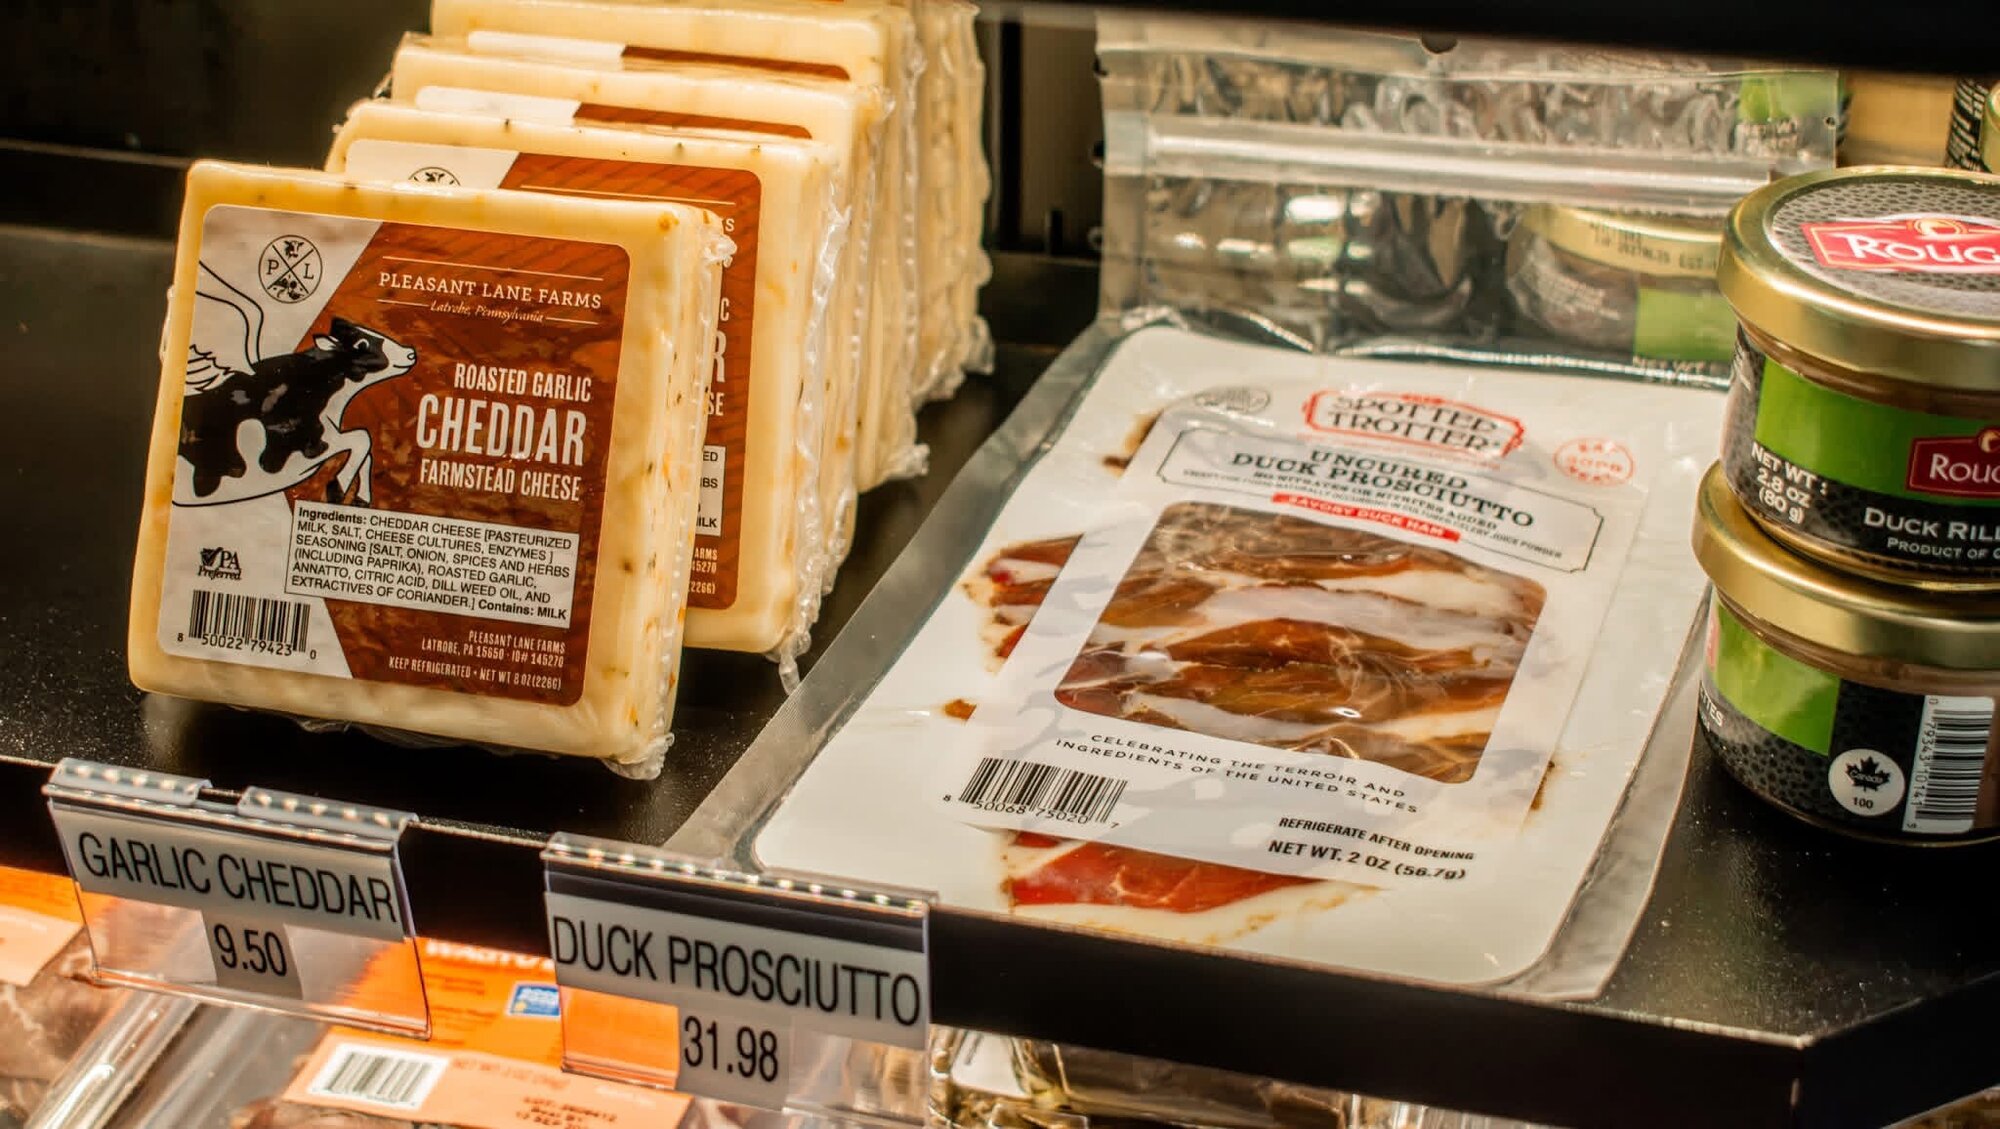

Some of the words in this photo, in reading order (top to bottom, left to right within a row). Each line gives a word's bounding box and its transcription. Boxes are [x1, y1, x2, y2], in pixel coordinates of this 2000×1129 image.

[378, 271, 477, 296] PLEASANT
[482, 282, 532, 302] LANE
[538, 288, 602, 309] FARMS
[430, 299, 471, 316] Latrobe,
[475, 304, 544, 324] Pennsylvania
[454, 363, 527, 395] ROASTED
[531, 371, 592, 402] GARLIC
[416, 394, 587, 466] CHEDDAR
[1328, 411, 1489, 450] TROTTER
[1332, 397, 1497, 432] SPOTTED
[420, 458, 515, 494] FARMSTEAD
[520, 470, 582, 501] CHEESE
[1311, 450, 1468, 489] UNCURED
[1751, 441, 1781, 472] NET
[1784, 461, 1817, 490] WT
[1231, 453, 1320, 476] DUCK
[1329, 467, 1534, 527] PROSCIUTTO
[1757, 467, 1784, 493] 2.8
[1786, 486, 1811, 509] OZ
[1759, 487, 1788, 513] (80
[297, 520, 328, 535] MILK,
[331, 524, 362, 540] SALT,
[365, 528, 415, 545] CHEESE
[417, 535, 485, 554] CULTURES,
[488, 544, 546, 561] ENZYMES
[298, 507, 367, 525] Ingredients:
[369, 515, 429, 532] CHEDDAR
[432, 522, 482, 539] CHEESE
[484, 529, 572, 550] [PASTEURIZED
[1356, 508, 1404, 526] DUCK
[1406, 519, 1445, 538] HAM
[1864, 507, 1940, 538] DUCK
[220, 551, 241, 570] PA
[294, 547, 363, 566] (INCLUDING
[367, 556, 424, 575] PAPRIKA),
[427, 565, 486, 582] ROASTED
[489, 572, 538, 589] GARLIC,
[296, 534, 366, 553] SEASONING
[369, 542, 403, 558] [SALT,
[406, 548, 448, 563] ONION,
[452, 553, 497, 569] SPICES
[499, 560, 525, 572] AND
[528, 562, 570, 578] HERBS
[694, 547, 718, 561] ARMS
[1887, 537, 1962, 558] PRODUCT
[1966, 548, 1987, 560] OF
[198, 565, 242, 581] Preferred
[293, 561, 351, 579] ANNATTO,
[354, 569, 395, 584] CITRIC
[396, 575, 428, 590] ACID,
[432, 579, 457, 592] DILL
[460, 582, 496, 597] WEED
[500, 587, 522, 600] OIL,
[525, 591, 551, 604] AND
[292, 575, 374, 596] EXTRACTIVES
[376, 586, 395, 597] OF
[396, 588, 475, 610] CORIANDER.]
[478, 599, 534, 616] Contains:
[537, 606, 567, 620] MILK
[177, 632, 184, 642] 8
[201, 633, 244, 651] 50022
[250, 639, 293, 657] 79423
[309, 649, 317, 660] 0
[421, 637, 461, 657] LATROBE,
[463, 643, 474, 656] PA
[530, 652, 564, 669] 145270
[468, 629, 512, 648] PLEASANT
[513, 634, 535, 651] LANE
[537, 638, 566, 654] FARMS
[388, 655, 410, 670] KEEP
[411, 658, 472, 679] REFRIGERATED
[479, 667, 496, 682] NET
[497, 669, 511, 685] WT
[1056, 739, 1183, 771] INGREDIENTS
[1191, 766, 1217, 775] OF
[1225, 769, 1259, 782] THE
[1267, 775, 1340, 793] UNITED
[1347, 788, 1418, 814] STATES
[1091, 734, 1222, 765] CELEBRATING
[1230, 759, 1266, 770] THE
[1273, 764, 1358, 785] TERROIR
[1364, 781, 1406, 798] AND
[943, 794, 952, 802] 8
[971, 800, 1027, 815] 50068
[1035, 807, 1089, 825] 75020
[1110, 821, 1120, 829] 7
[1853, 797, 1873, 809] 100
[1278, 816, 1367, 840] REFRIGERATE
[1368, 832, 1412, 852] AFTER
[1414, 844, 1475, 861] OPENING
[78, 832, 211, 895] GARLIC
[218, 853, 397, 923] CHEDDAR
[1268, 839, 1308, 856] NET
[1310, 844, 1342, 862] WT.
[1347, 851, 1361, 864] 2
[1364, 854, 1391, 871] OZ
[1394, 862, 1466, 881] (56.7g)
[213, 923, 287, 977] 9.50
[553, 916, 657, 981] DUCK
[669, 935, 921, 1027] PROSCIUTTO
[683, 1015, 779, 1083] 31.98
